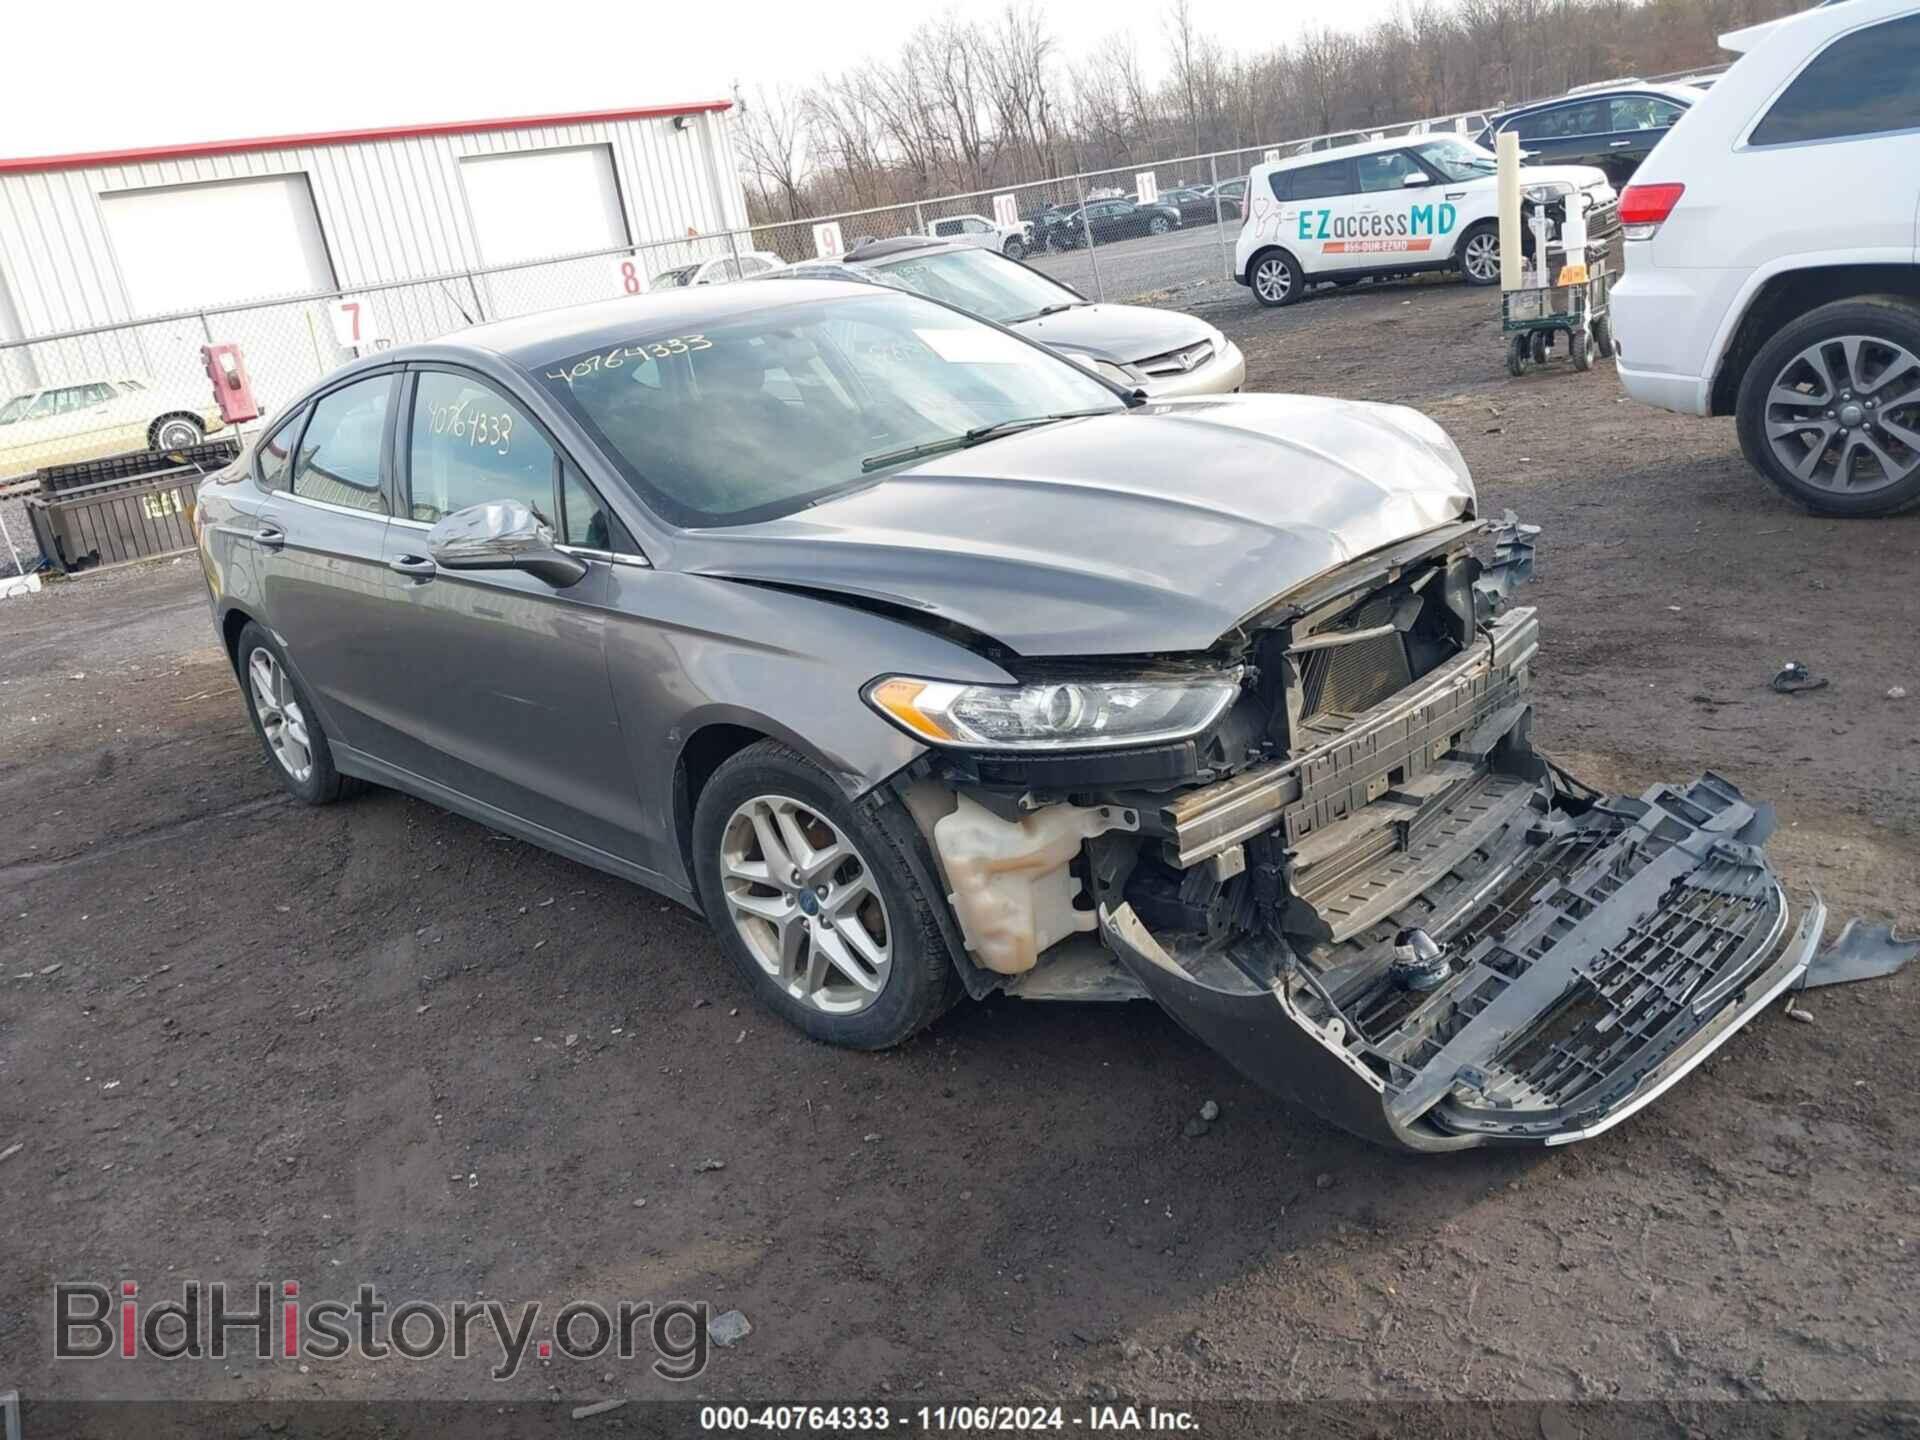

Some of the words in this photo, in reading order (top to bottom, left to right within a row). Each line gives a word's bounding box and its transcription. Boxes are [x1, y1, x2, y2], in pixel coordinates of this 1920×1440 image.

[996, 198, 1016, 226] 10
[1298, 203, 1457, 240] EZaccessMD
[822, 227, 836, 257] 9
[621, 261, 640, 295] 8
[341, 303, 360, 341] 7
[546, 334, 713, 384] 40764333
